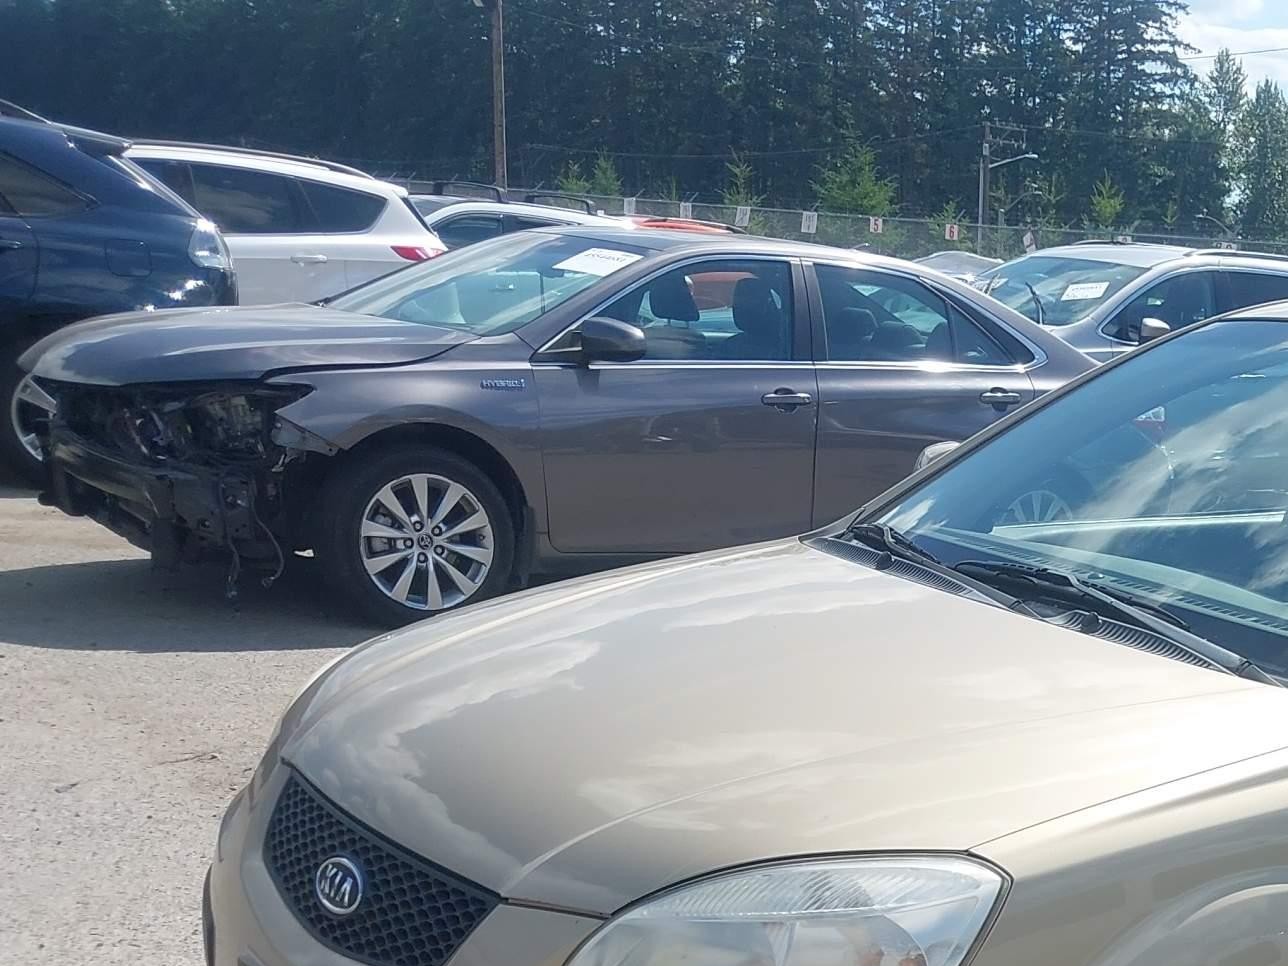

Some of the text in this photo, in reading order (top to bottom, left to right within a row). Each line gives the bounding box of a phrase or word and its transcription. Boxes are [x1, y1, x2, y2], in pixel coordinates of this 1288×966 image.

[873, 218, 880, 232] 5
[949, 225, 955, 238] 6
[320, 863, 353, 907] KIA
